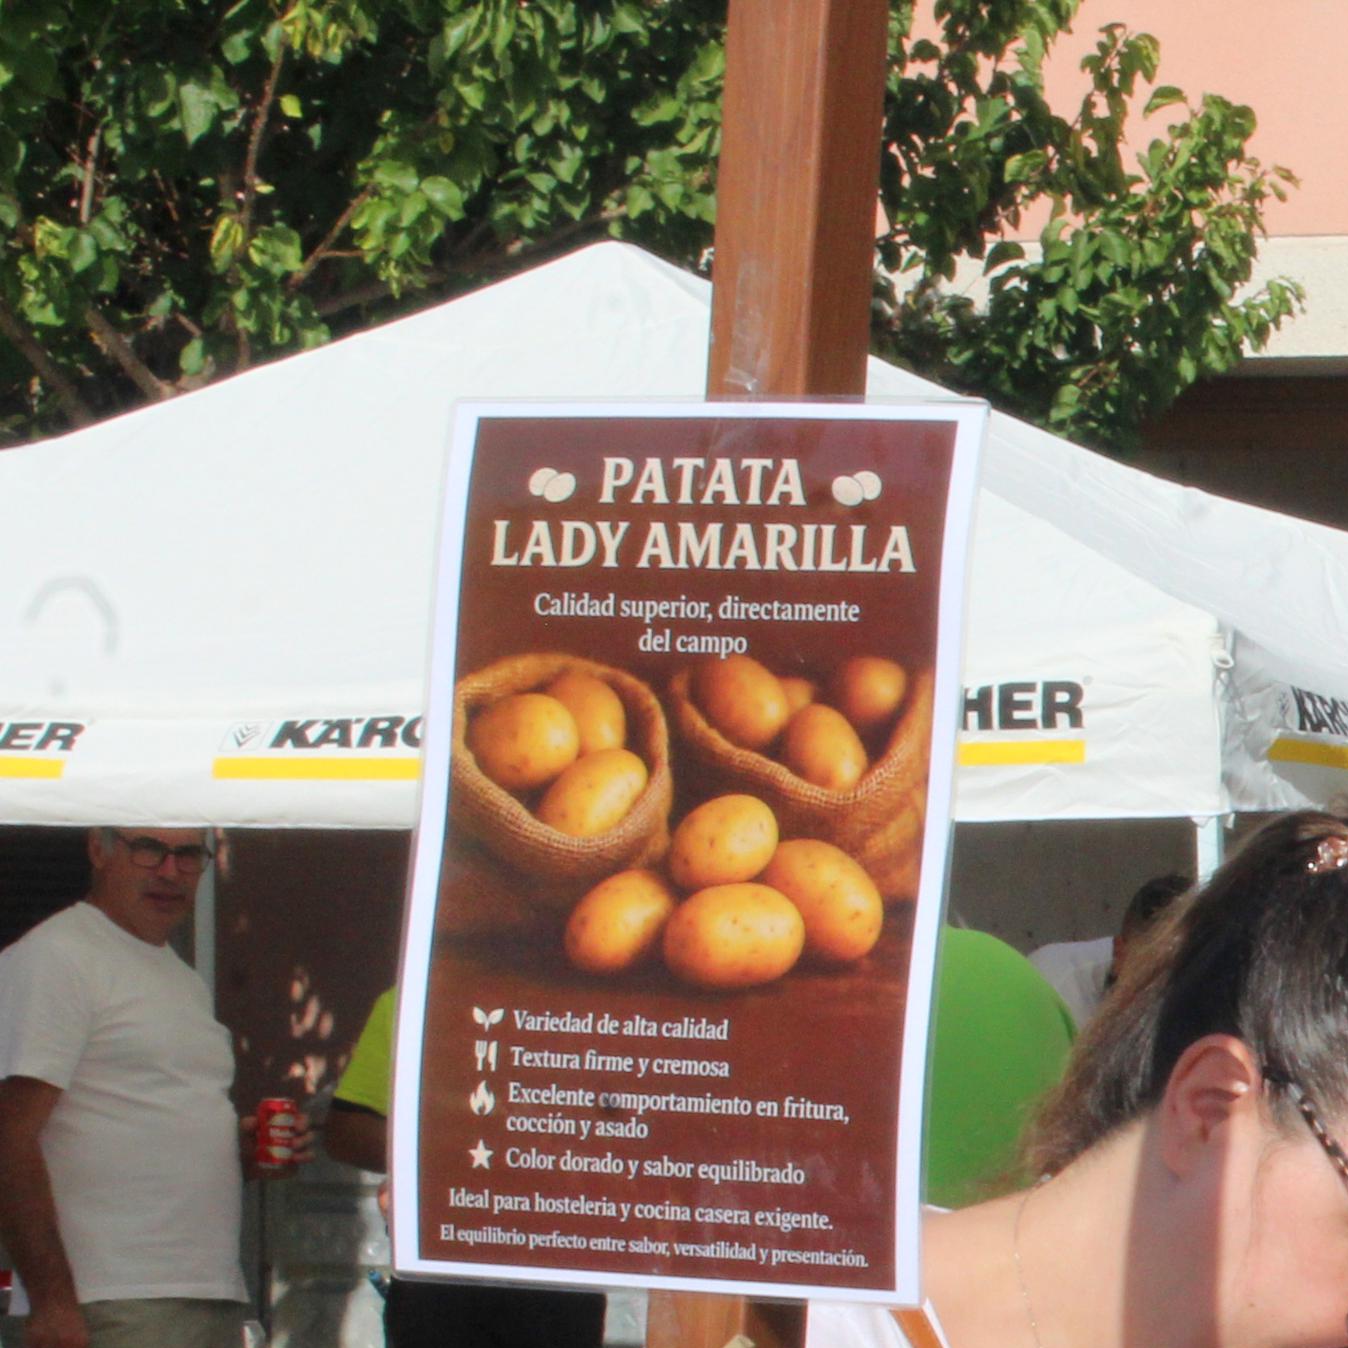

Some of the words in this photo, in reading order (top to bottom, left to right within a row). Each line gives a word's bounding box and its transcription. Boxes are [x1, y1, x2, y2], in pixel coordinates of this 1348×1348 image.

[598, 456, 807, 506] PATATA
[490, 519, 628, 569] LADY
[636, 523, 917, 573] AMARILLA
[534, 591, 614, 618] Calidad
[620, 596, 714, 622] superior,
[718, 597, 860, 622] directamente
[638, 628, 671, 655] del
[676, 634, 747, 660] campo
[0, 720, 86, 751] ER
[513, 1009, 594, 1036] Variedad
[596, 1012, 620, 1035] de
[623, 1014, 658, 1038] alta
[662, 1015, 729, 1041] calidad
[510, 1046, 581, 1070] Textura
[584, 1048, 633, 1073] firme
[637, 1057, 650, 1077] y
[653, 1055, 730, 1078] cremosa
[508, 1082, 595, 1107] Excelente
[599, 1087, 752, 1118] comportamiento
[755, 1097, 780, 1118] en
[783, 1096, 850, 1124] fritura,
[506, 1112, 577, 1138] cocción
[579, 1121, 592, 1140] y
[595, 1115, 649, 1140] asado
[505, 1147, 557, 1172] Color
[559, 1149, 624, 1176] dorado
[627, 1159, 641, 1179] y
[643, 1154, 694, 1179] sabor
[697, 1157, 806, 1186] equilibrado
[448, 1187, 491, 1209] Ideal
[492, 1194, 531, 1214] para
[619, 1202, 632, 1222] y
[634, 1199, 692, 1223] cocina
[695, 1205, 751, 1227] casera
[754, 1206, 834, 1234] exigente.
[440, 1224, 454, 1241] El
[456, 1225, 526, 1248] equilibrio
[528, 1228, 587, 1252] perfecto
[588, 1233, 627, 1251] entre
[628, 1235, 671, 1258] sabor,
[673, 1238, 757, 1262] versatilidad
[758, 1247, 770, 1265] y
[771, 1245, 869, 1270] presentación.
